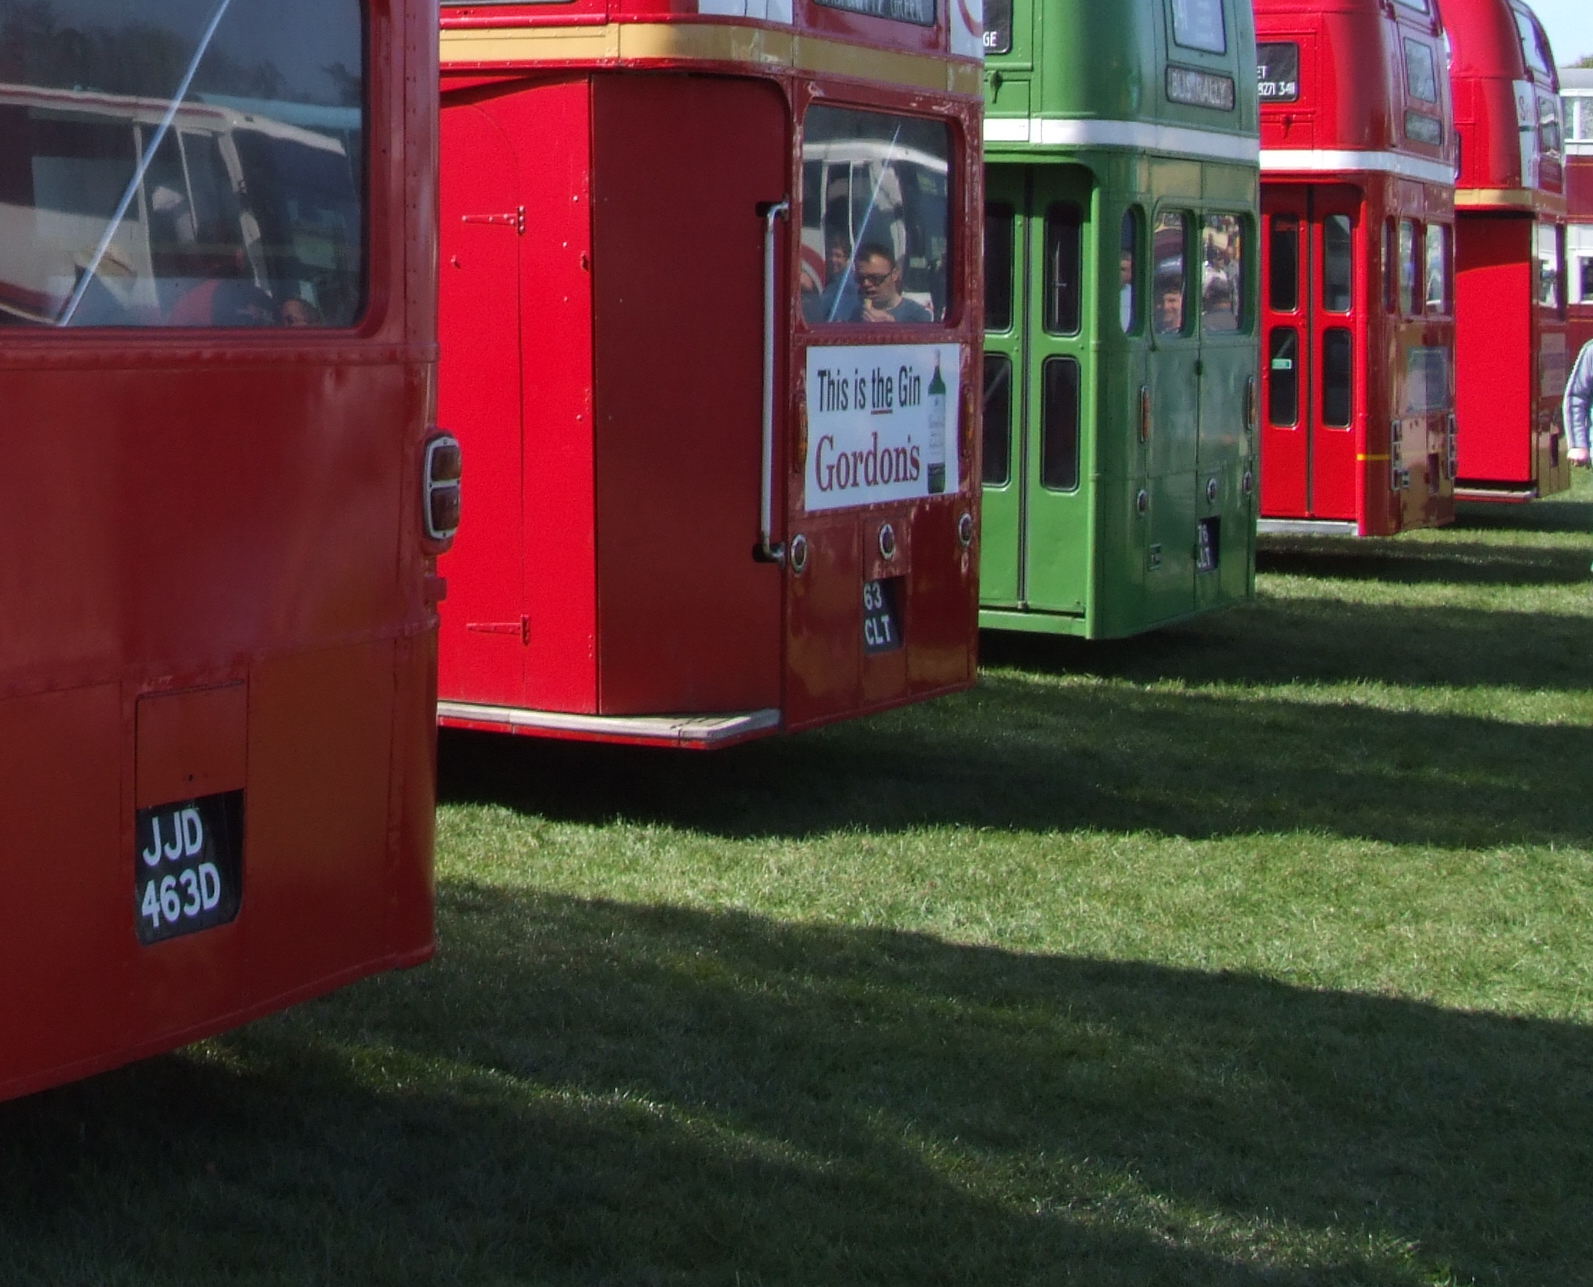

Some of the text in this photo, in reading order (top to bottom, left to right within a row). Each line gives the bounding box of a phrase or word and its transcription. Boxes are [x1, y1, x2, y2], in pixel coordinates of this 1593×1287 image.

[817, 365, 921, 412] This is the Gin
[815, 431, 921, 492] Gordon's
[863, 581, 883, 610] 63
[864, 616, 893, 646] CLT
[142, 808, 203, 866] JJD
[141, 862, 221, 928] 463D
